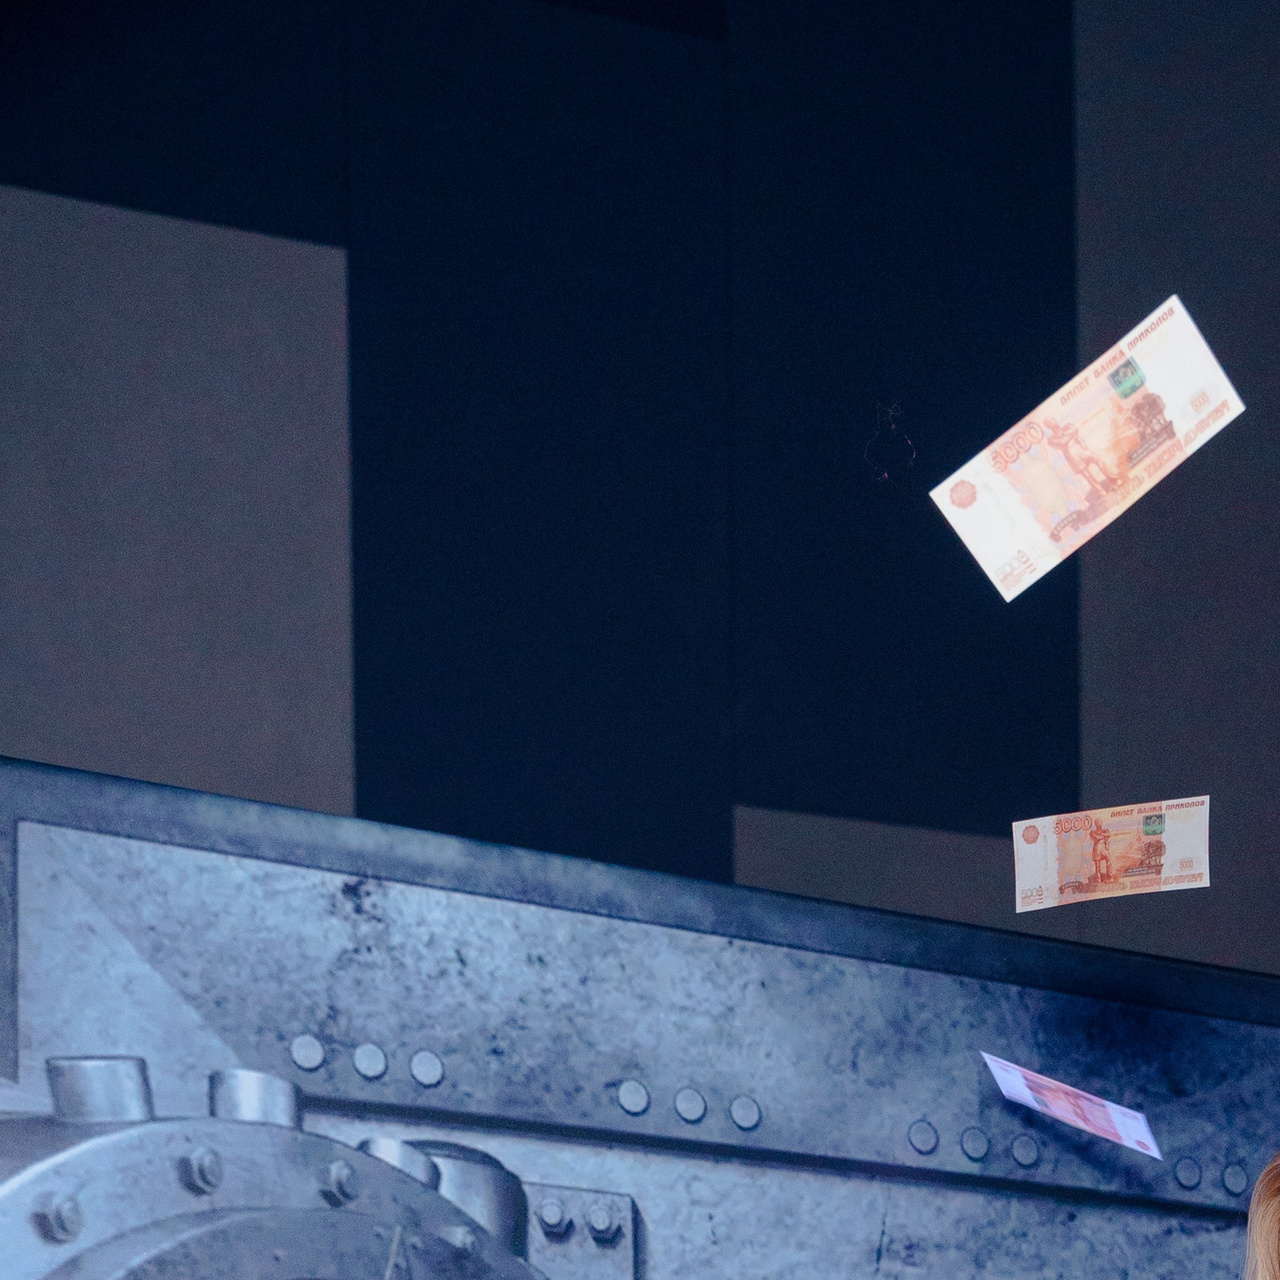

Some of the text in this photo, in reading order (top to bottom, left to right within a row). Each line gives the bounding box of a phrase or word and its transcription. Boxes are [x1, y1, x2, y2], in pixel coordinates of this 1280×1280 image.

[988, 421, 1045, 474] 5000
[1165, 799, 1206, 811] ПРИКОЛОВ
[1052, 815, 1093, 835] 5000
